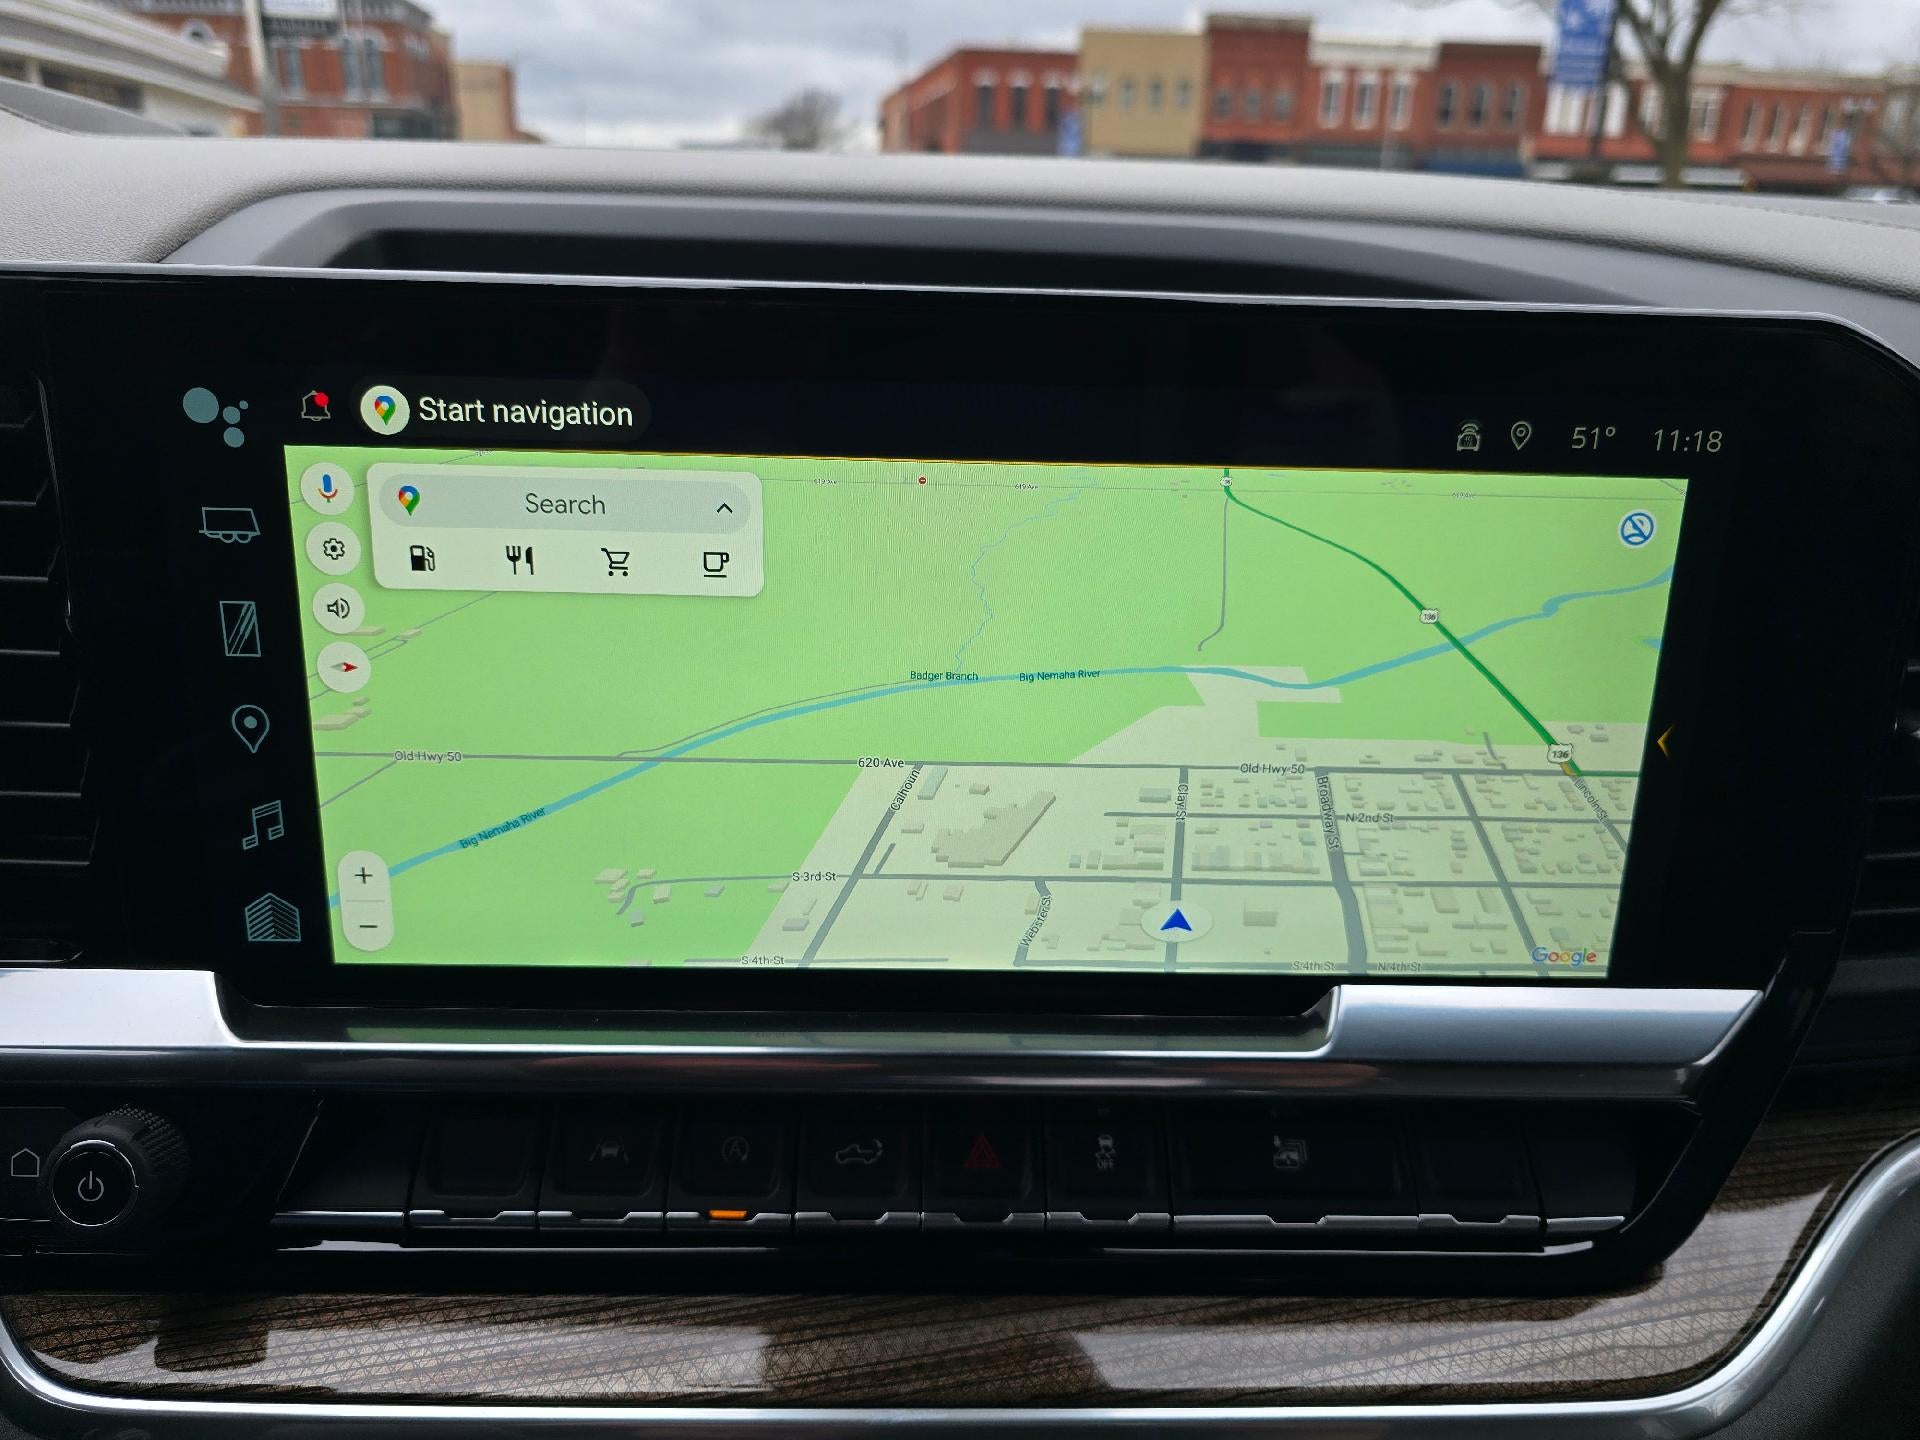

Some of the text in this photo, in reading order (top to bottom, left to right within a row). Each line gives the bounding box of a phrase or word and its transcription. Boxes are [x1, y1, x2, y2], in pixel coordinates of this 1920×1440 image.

[418, 397, 633, 430] Start navigation
[1571, 425, 1617, 449] 51°
[1653, 429, 1723, 453] 11:18
[525, 493, 606, 516] Search
[910, 670, 979, 683] Badger Branch
[1019, 668, 1101, 683] Big Nemaha River
[394, 750, 462, 766] Old Hwy 50
[858, 757, 904, 768] 620 Ave
[1551, 750, 1570, 760] 136
[1240, 763, 1305, 776] Old Hwy 50
[890, 769, 920, 811] Calhoun
[1176, 783, 1190, 823] Clay St
[1317, 775, 1339, 851] Broadway St
[1346, 812, 1395, 823] N 2nd St
[459, 807, 546, 849] Big Nemaha River
[793, 871, 837, 882] S 3rd St
[1020, 907, 1049, 946] Webster
[741, 954, 785, 966] S 4th St
[1532, 946, 1597, 966] Google
[1293, 961, 1336, 972] S 4th St
[1378, 961, 1422, 972] N 4th St
[1096, 1159, 1115, 1169] OFF
